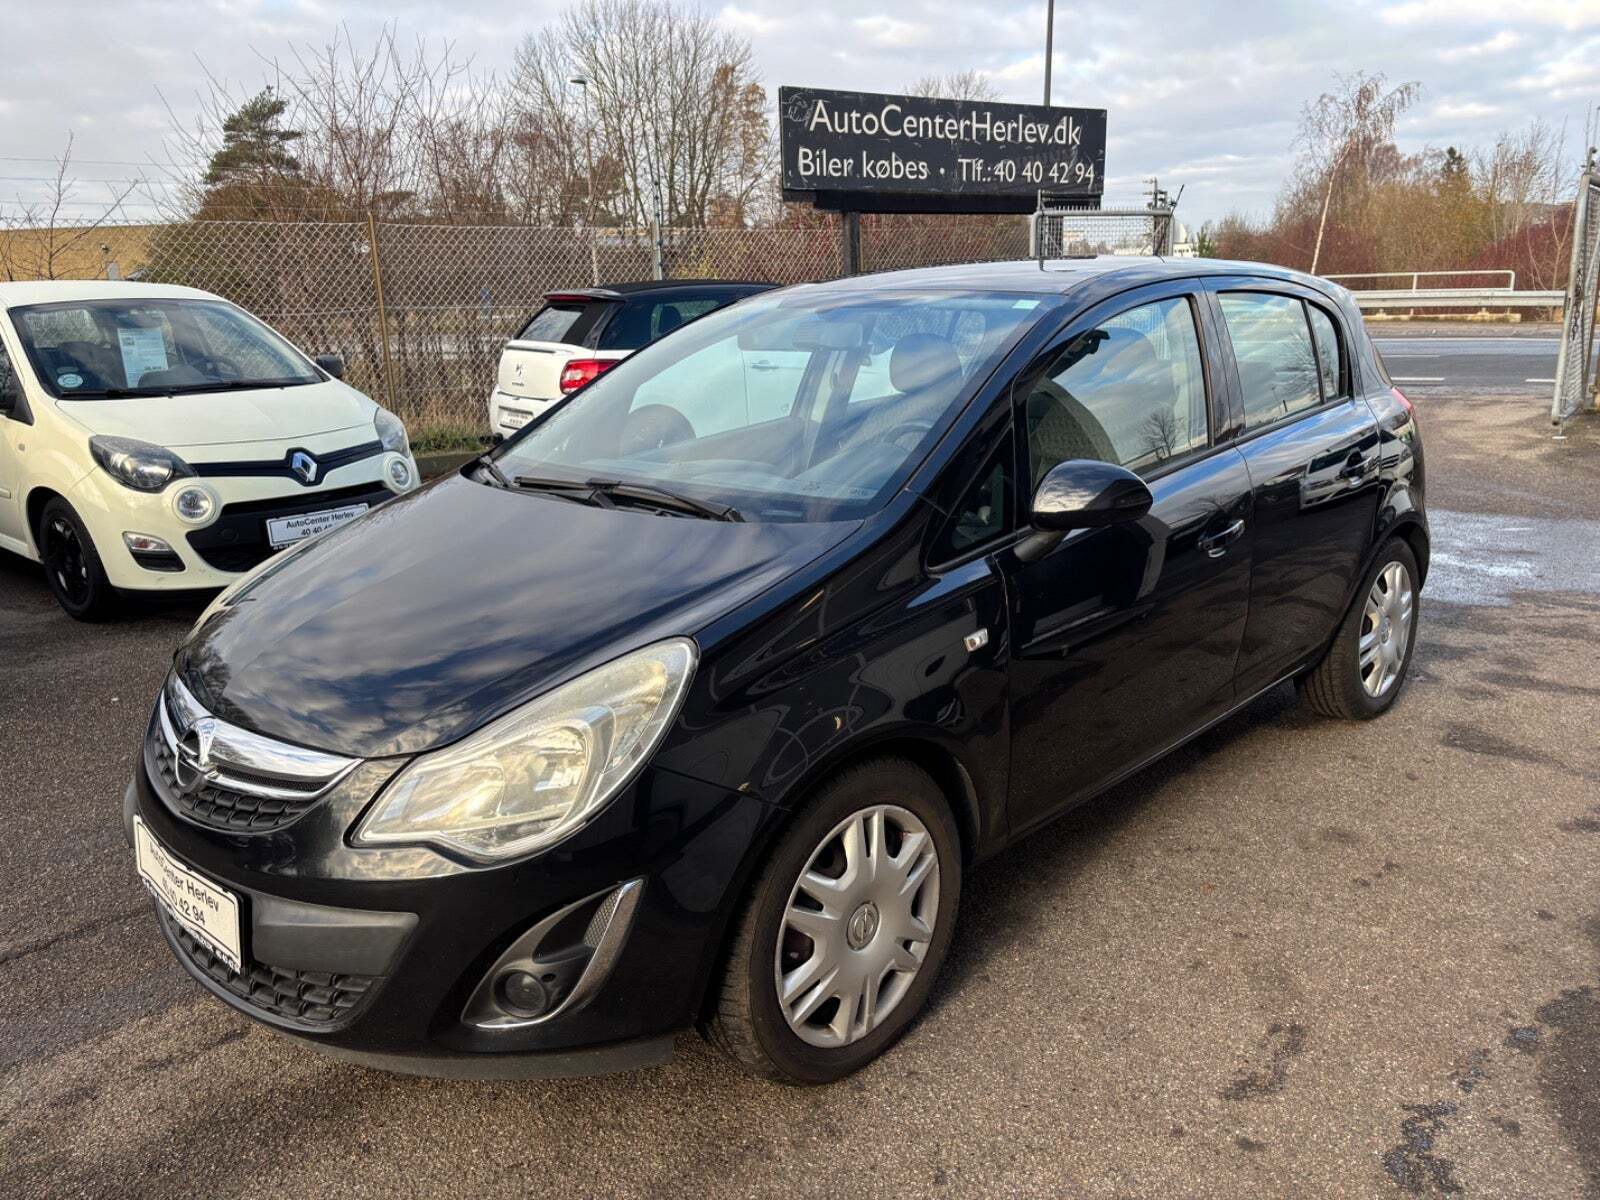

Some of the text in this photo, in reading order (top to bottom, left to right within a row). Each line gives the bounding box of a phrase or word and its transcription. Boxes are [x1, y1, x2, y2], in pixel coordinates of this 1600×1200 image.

[809, 99, 1082, 146] AutoCenterHerlev.dk
[798, 148, 853, 178] Biler
[862, 150, 929, 181] købes
[1021, 160, 1043, 183] 40
[1048, 161, 1070, 184] 42
[1075, 161, 1095, 186] 94
[286, 516, 330, 529] AutoCenter
[331, 511, 354, 520] Herlev
[179, 898, 206, 926] 42 94
[186, 879, 220, 912] Herlev
